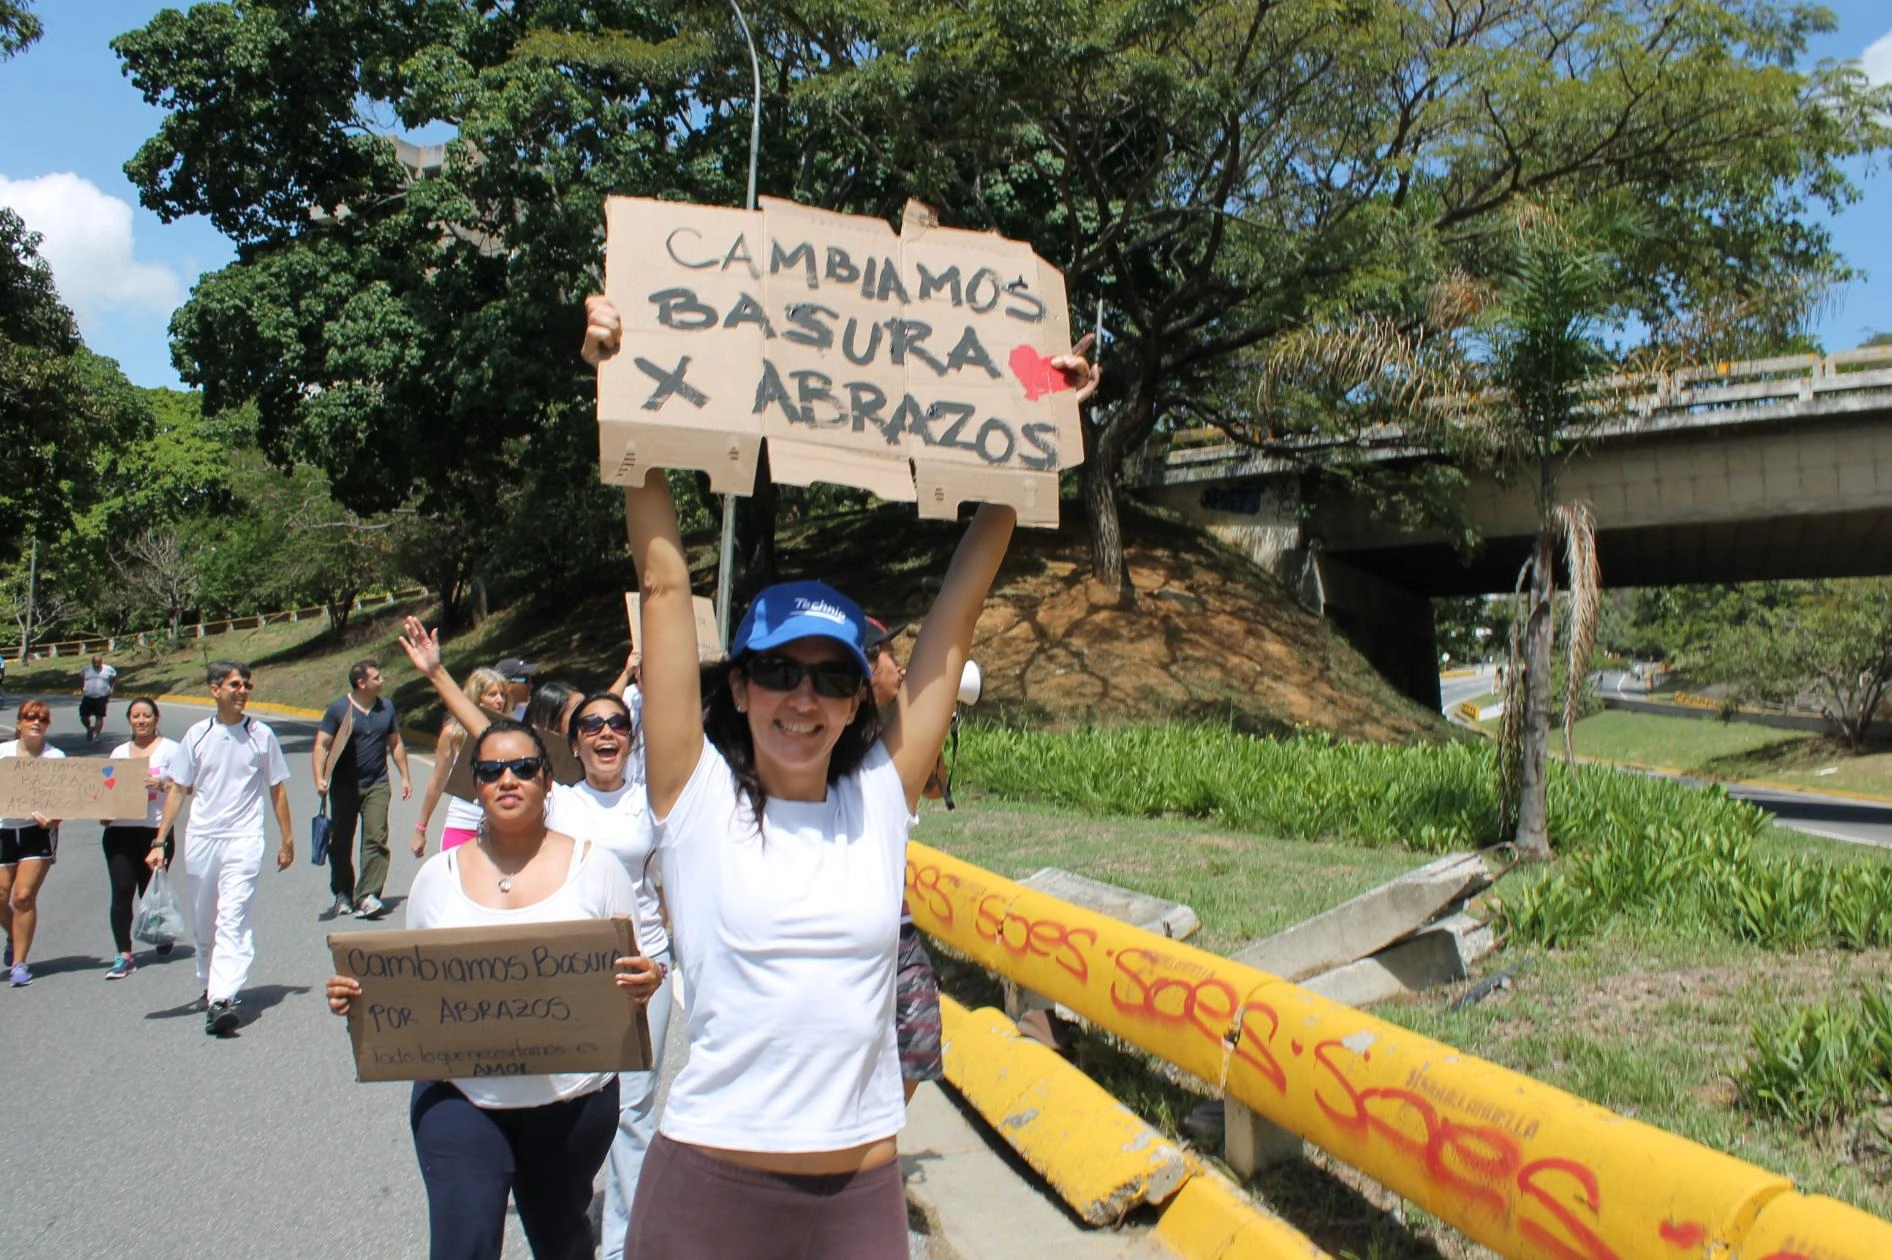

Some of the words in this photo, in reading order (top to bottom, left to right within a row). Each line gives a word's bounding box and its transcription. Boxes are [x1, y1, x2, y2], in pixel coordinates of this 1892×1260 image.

[665, 227, 1047, 323] CAMBIAMOS
[648, 287, 1002, 379] BASURA
[634, 355, 710, 410] X
[752, 358, 1060, 470] ABRAZOS
